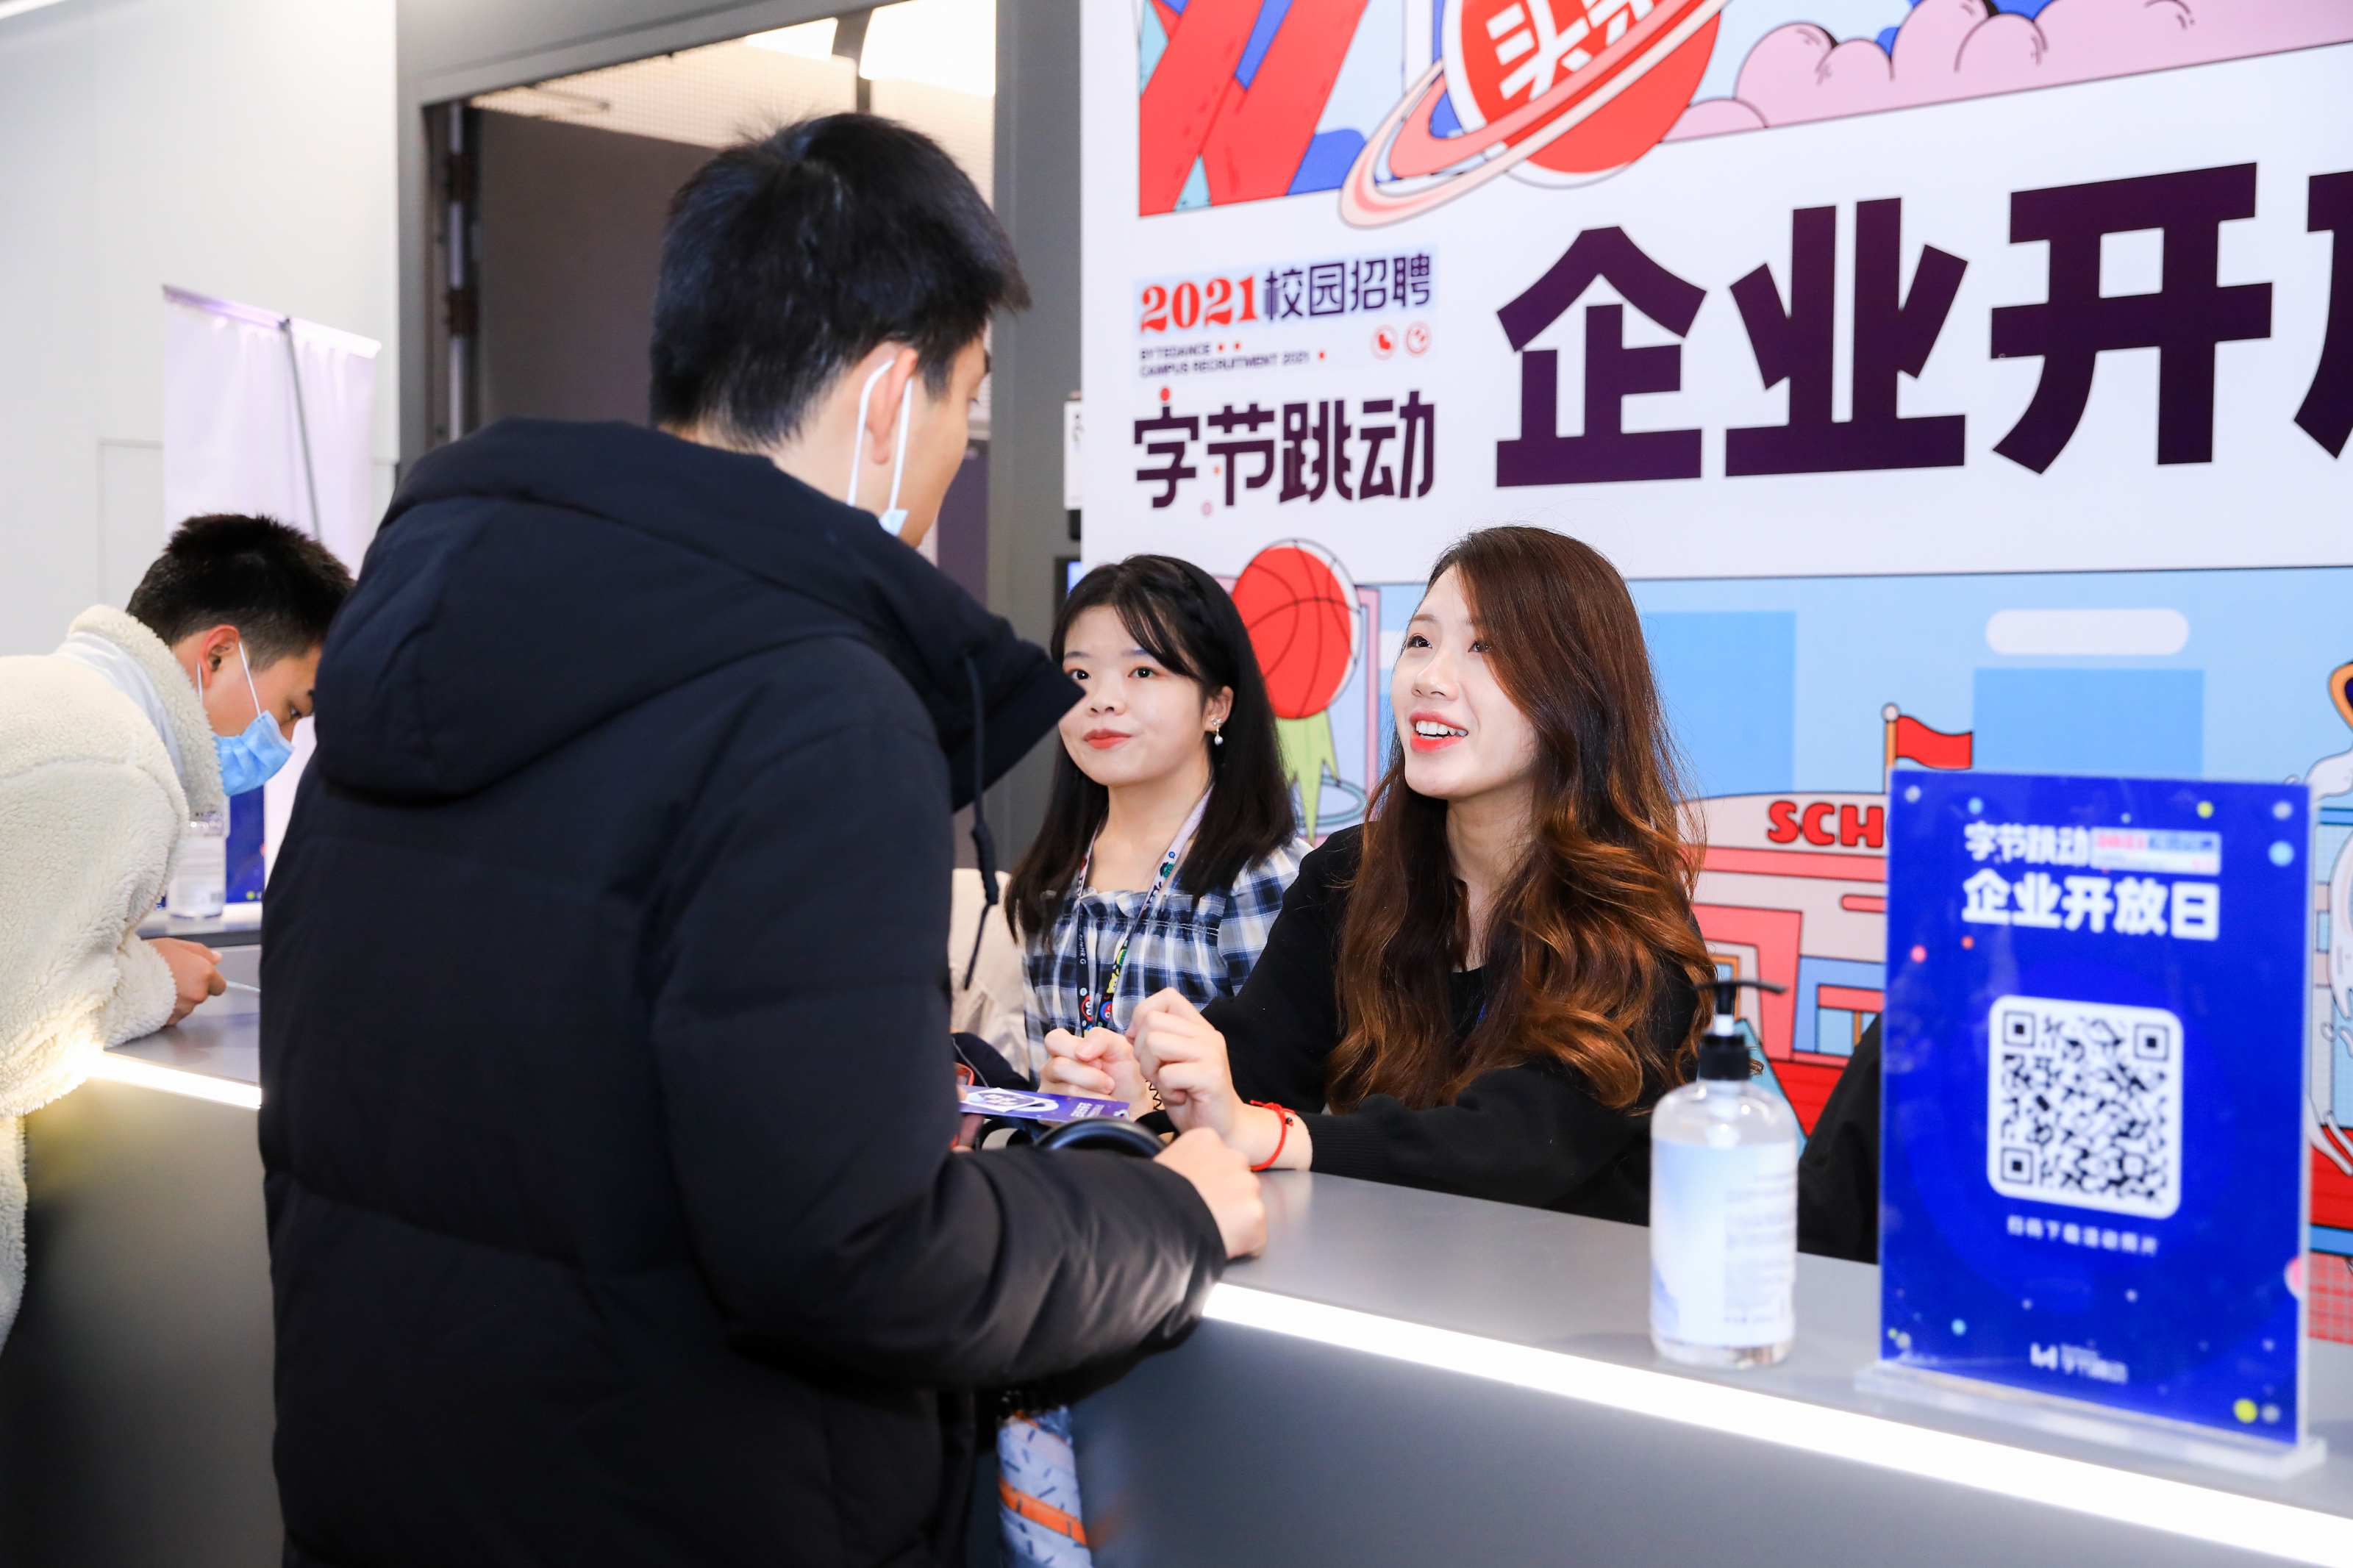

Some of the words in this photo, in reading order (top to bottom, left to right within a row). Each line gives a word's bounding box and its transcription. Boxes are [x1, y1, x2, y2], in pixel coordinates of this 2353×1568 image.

[1140, 253, 1430, 333] 2021校园招聘
[1135, 390, 1435, 509] 字节跳动
[1767, 801, 1884, 848] SCH
[1961, 867, 2220, 941] 企业开放日
